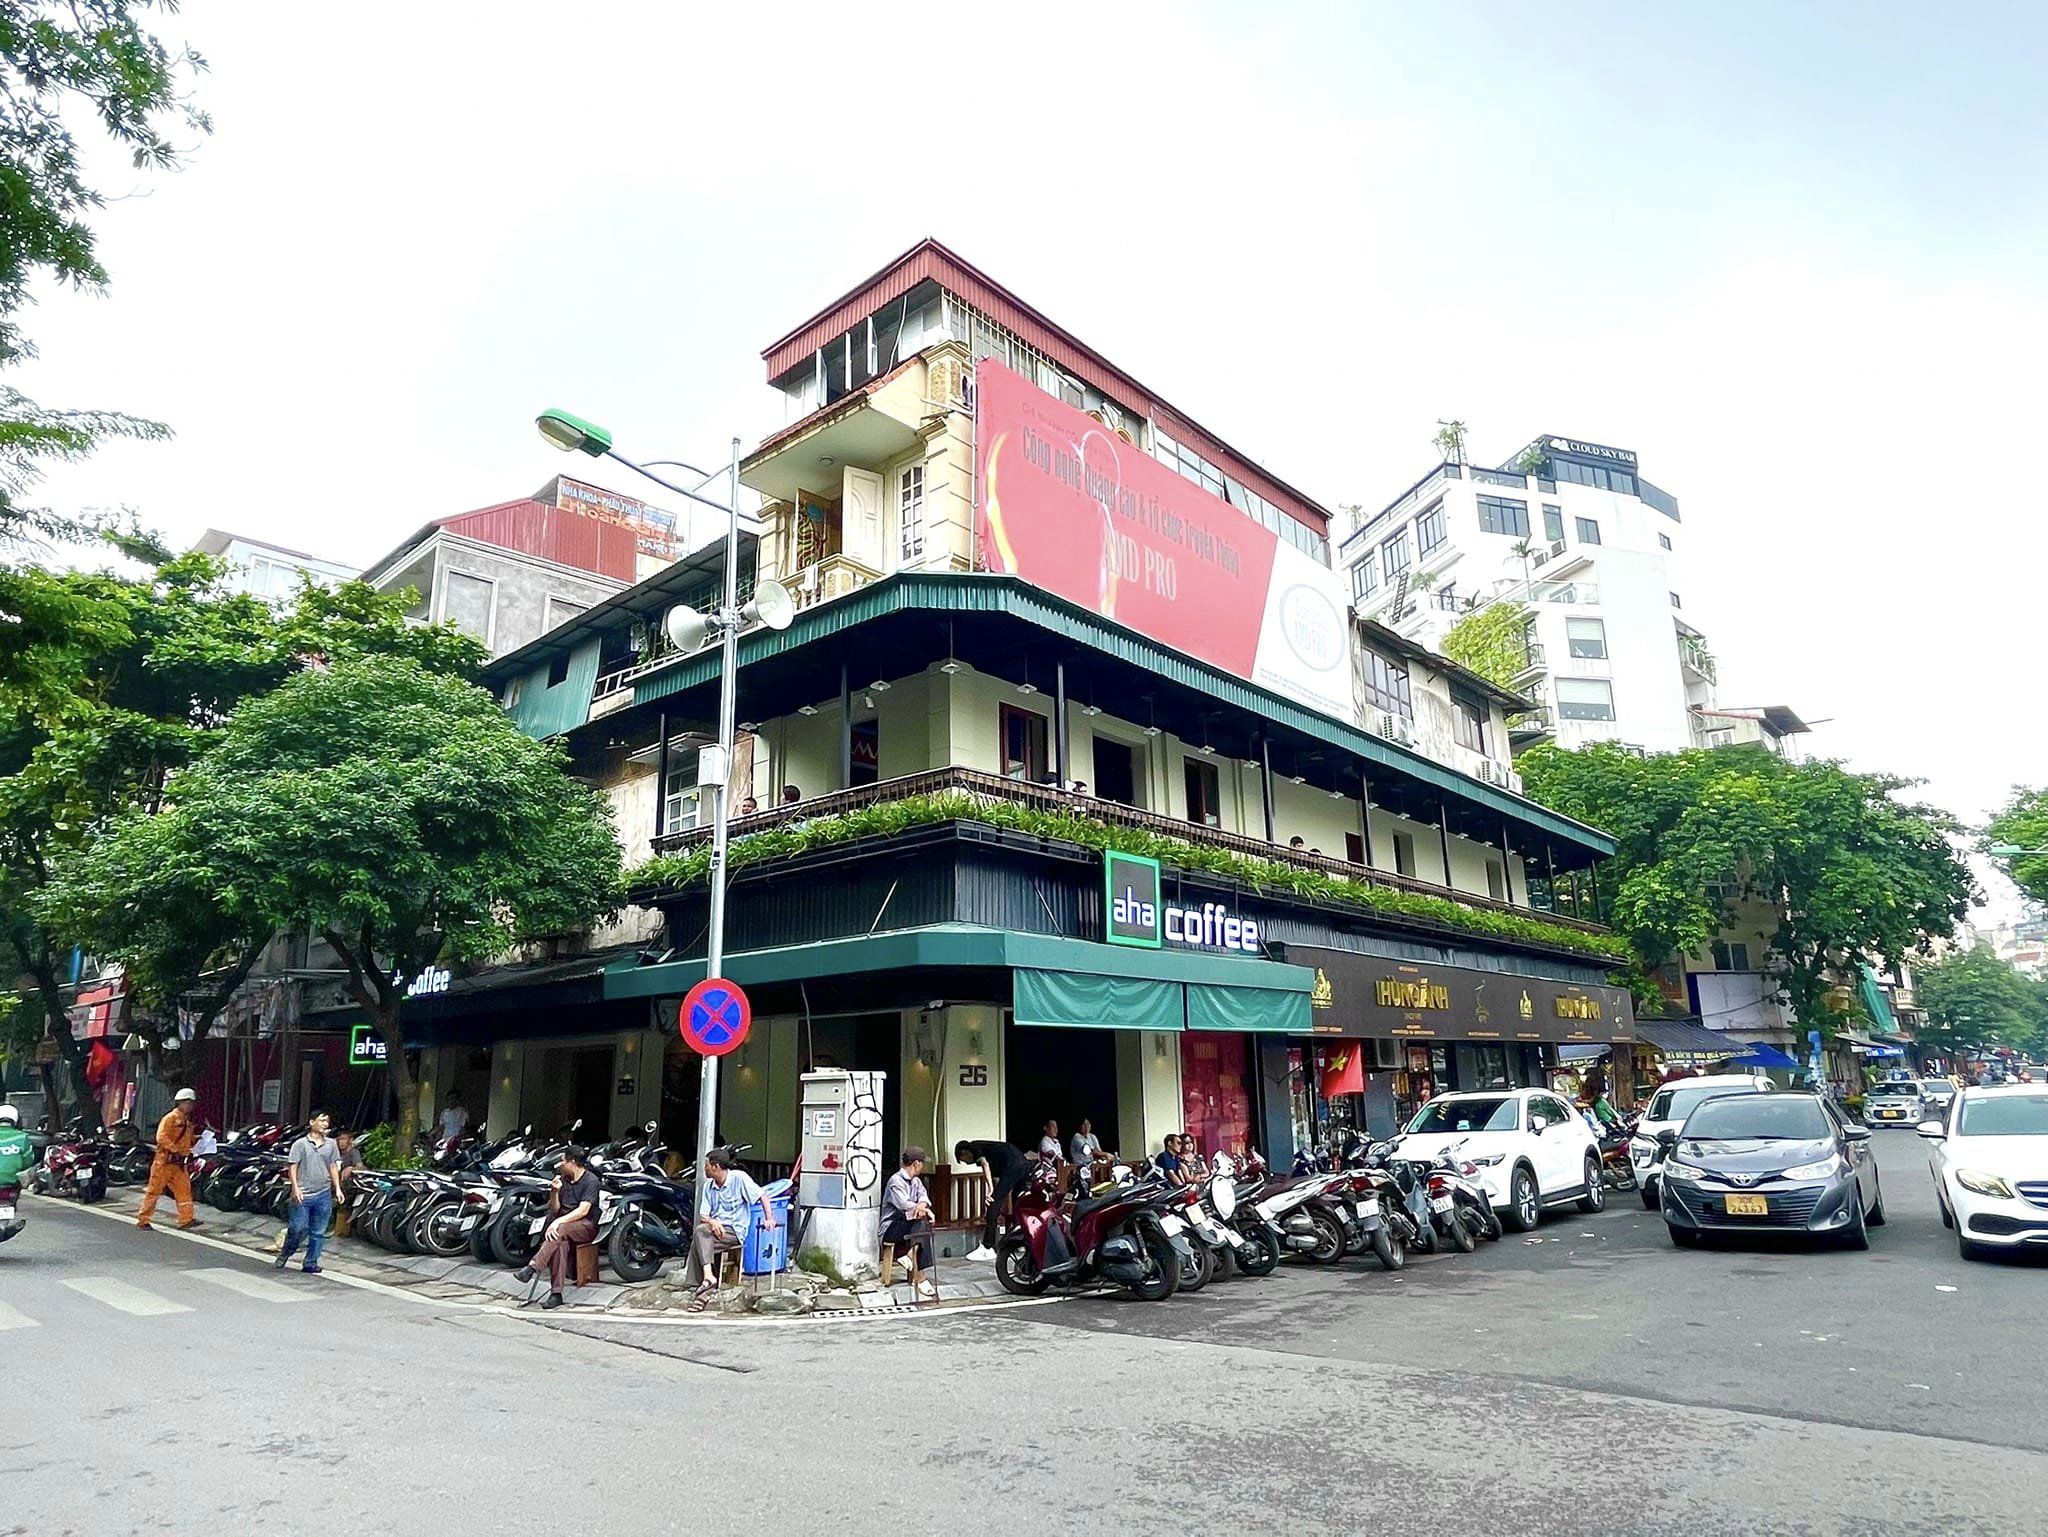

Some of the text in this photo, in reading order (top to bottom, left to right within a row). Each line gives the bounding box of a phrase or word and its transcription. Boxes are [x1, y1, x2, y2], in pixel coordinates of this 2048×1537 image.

[1570, 442, 1635, 462] CLOUD SKY BAR
[1144, 539, 1178, 602] PRO
[1113, 885, 1259, 951] aha coffee
[354, 1036, 387, 1055] aha
[959, 1064, 987, 1087] 26
[617, 1079, 635, 1095] 26
